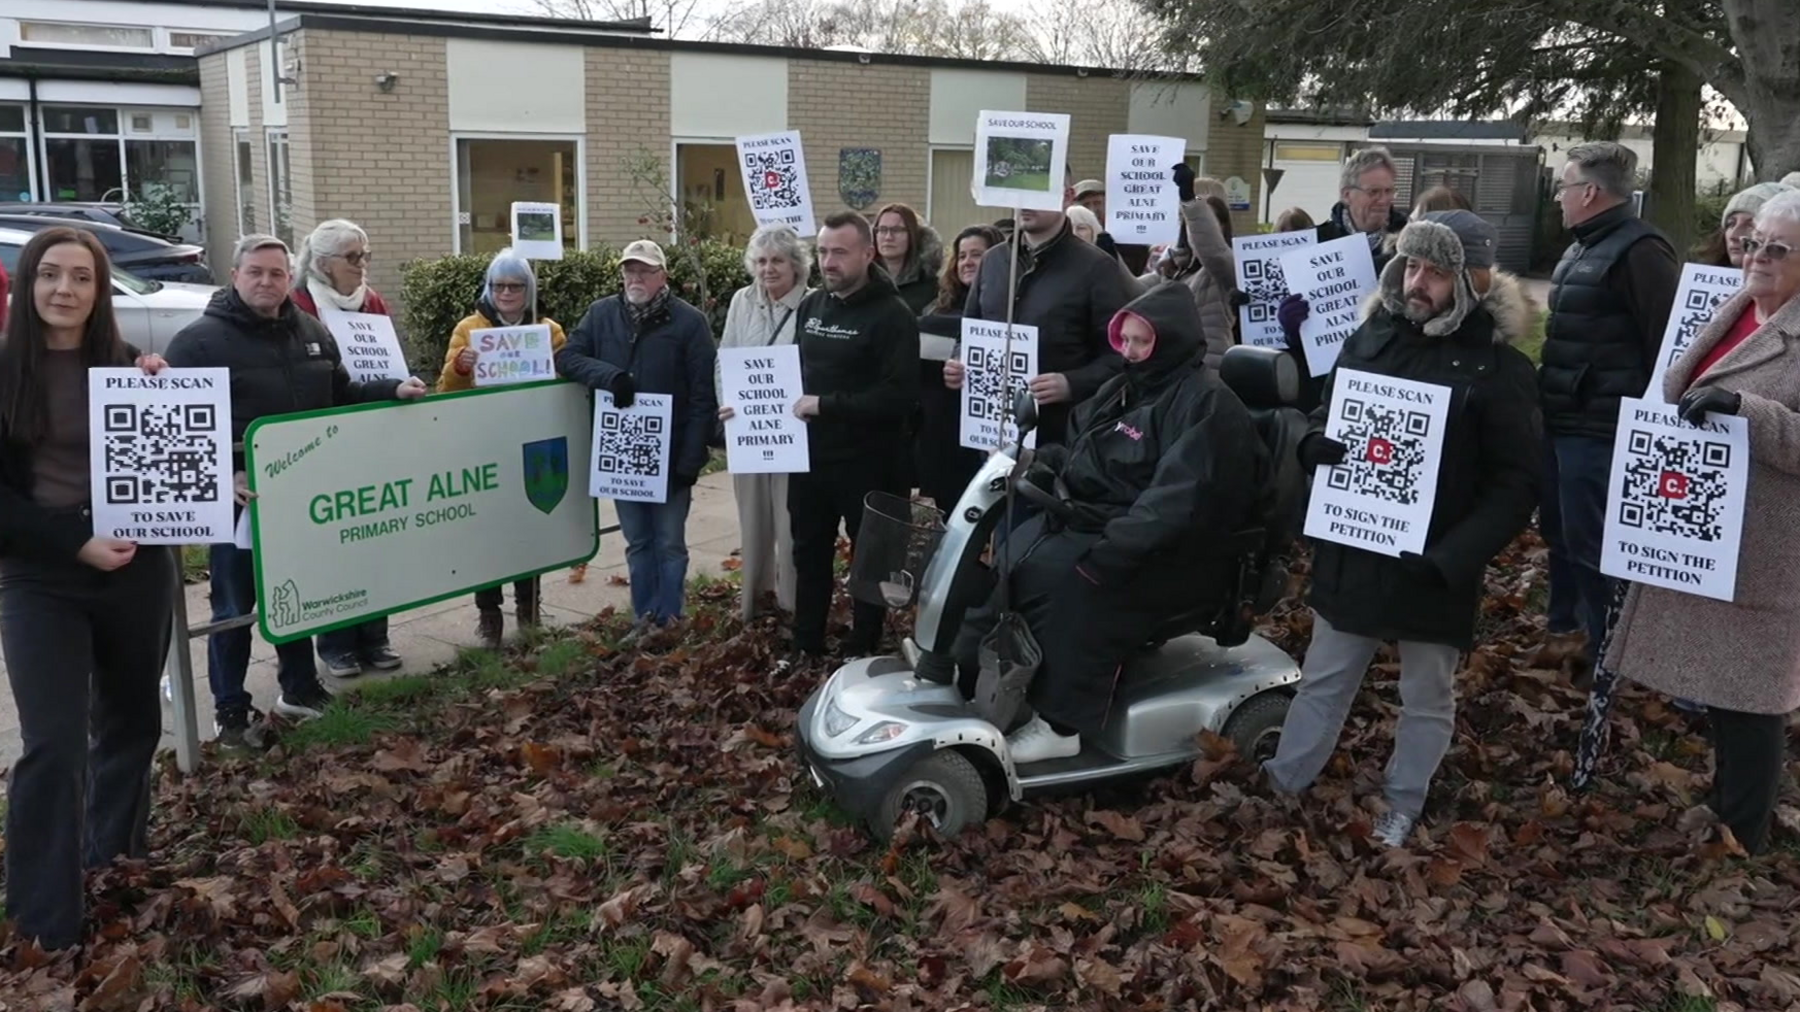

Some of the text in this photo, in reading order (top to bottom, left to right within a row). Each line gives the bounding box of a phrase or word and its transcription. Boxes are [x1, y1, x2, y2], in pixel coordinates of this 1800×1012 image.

[988, 119, 1008, 127] SAVE
[1024, 121, 1057, 129] SCHOOL
[743, 137, 792, 149] PLEASE SCAN
[1131, 145, 1160, 153] SAVE
[1131, 158, 1157, 167] OUR
[1120, 171, 1166, 180] SCHOOL
[1123, 184, 1161, 194] GREAT
[1128, 198, 1158, 207] ALNE
[1116, 210, 1167, 221] PRIMARY
[1242, 236, 1308, 251] PLEASE SCAN
[1310, 251, 1344, 268] SAVE
[1316, 267, 1346, 282] OUR
[1693, 273, 1741, 287] PLEASE
[1308, 279, 1361, 300] SCHOOL
[1315, 295, 1359, 314] GREAT
[348, 321, 374, 331] SAVE
[1325, 312, 1359, 328] ALNE
[970, 326, 1003, 338] PLEASE
[1315, 328, 1356, 346] PRIM
[353, 334, 378, 343] OUR
[480, 333, 538, 352] SAVE
[1253, 338, 1275, 346] OUR
[347, 346, 391, 357] SCHOOL
[353, 360, 390, 369] GREAT
[477, 359, 550, 378] SCHOOL!
[744, 359, 775, 369] SAVE
[105, 378, 214, 390] PLEASE SCAN
[748, 374, 775, 384] OUR
[738, 389, 788, 401] SCHOOL
[1348, 380, 1434, 404] PLEASE SCAN
[639, 399, 664, 407] SCAN
[743, 404, 785, 415] GREAT
[750, 420, 782, 430] ALNE
[1635, 409, 1685, 429] PLEASE
[981, 425, 1015, 438] TO SVE
[737, 434, 794, 446] PRIMARY
[969, 435, 988, 445] OUR
[265, 425, 339, 479] Welcome to
[763, 450, 774, 460] !!!
[611, 478, 646, 487] TO SAVE
[309, 463, 499, 525] GREAT ALNE
[600, 486, 655, 498] OUR SCHOOL
[131, 511, 196, 523] TO SAVE
[1323, 503, 1410, 533] TO SIGN THE
[340, 503, 477, 544] PRIMARY SCHOOL
[113, 526, 214, 539] OUR SCHOOL
[1330, 521, 1396, 546] PETITION
[1618, 541, 1716, 571] TO SIGN THE
[1627, 559, 1702, 585] PETITION
[302, 589, 367, 610] Warwickshire
[302, 599, 369, 621] County Council
